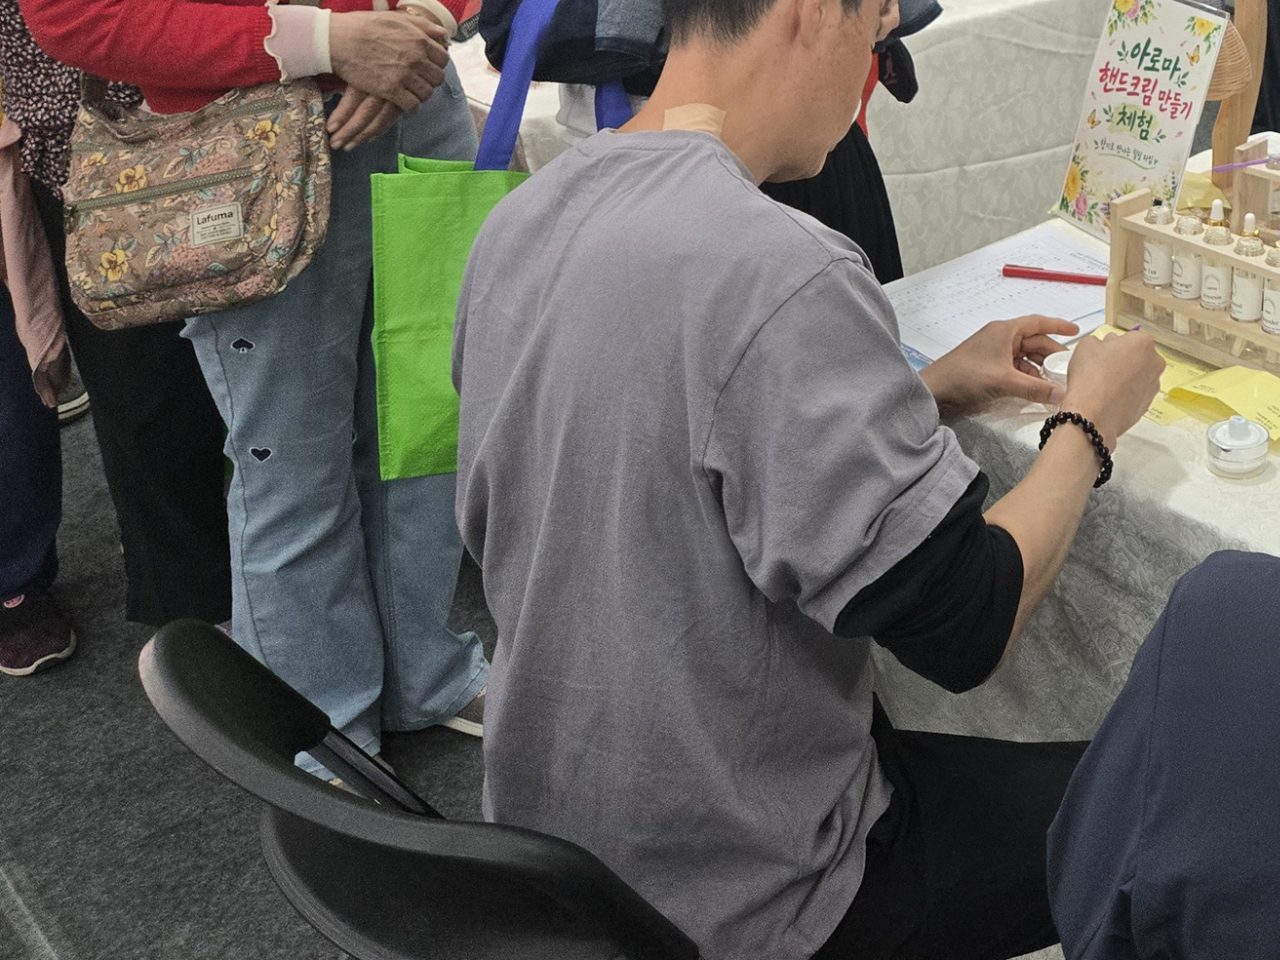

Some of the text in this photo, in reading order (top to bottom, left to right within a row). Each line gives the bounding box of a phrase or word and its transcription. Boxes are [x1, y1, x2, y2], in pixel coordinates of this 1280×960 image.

[1130, 37, 1181, 81] 아로마
[1099, 61, 1193, 120] 핸드크림 만들기
[1117, 106, 1153, 140] 체험
[196, 211, 234, 225] Lafuma
